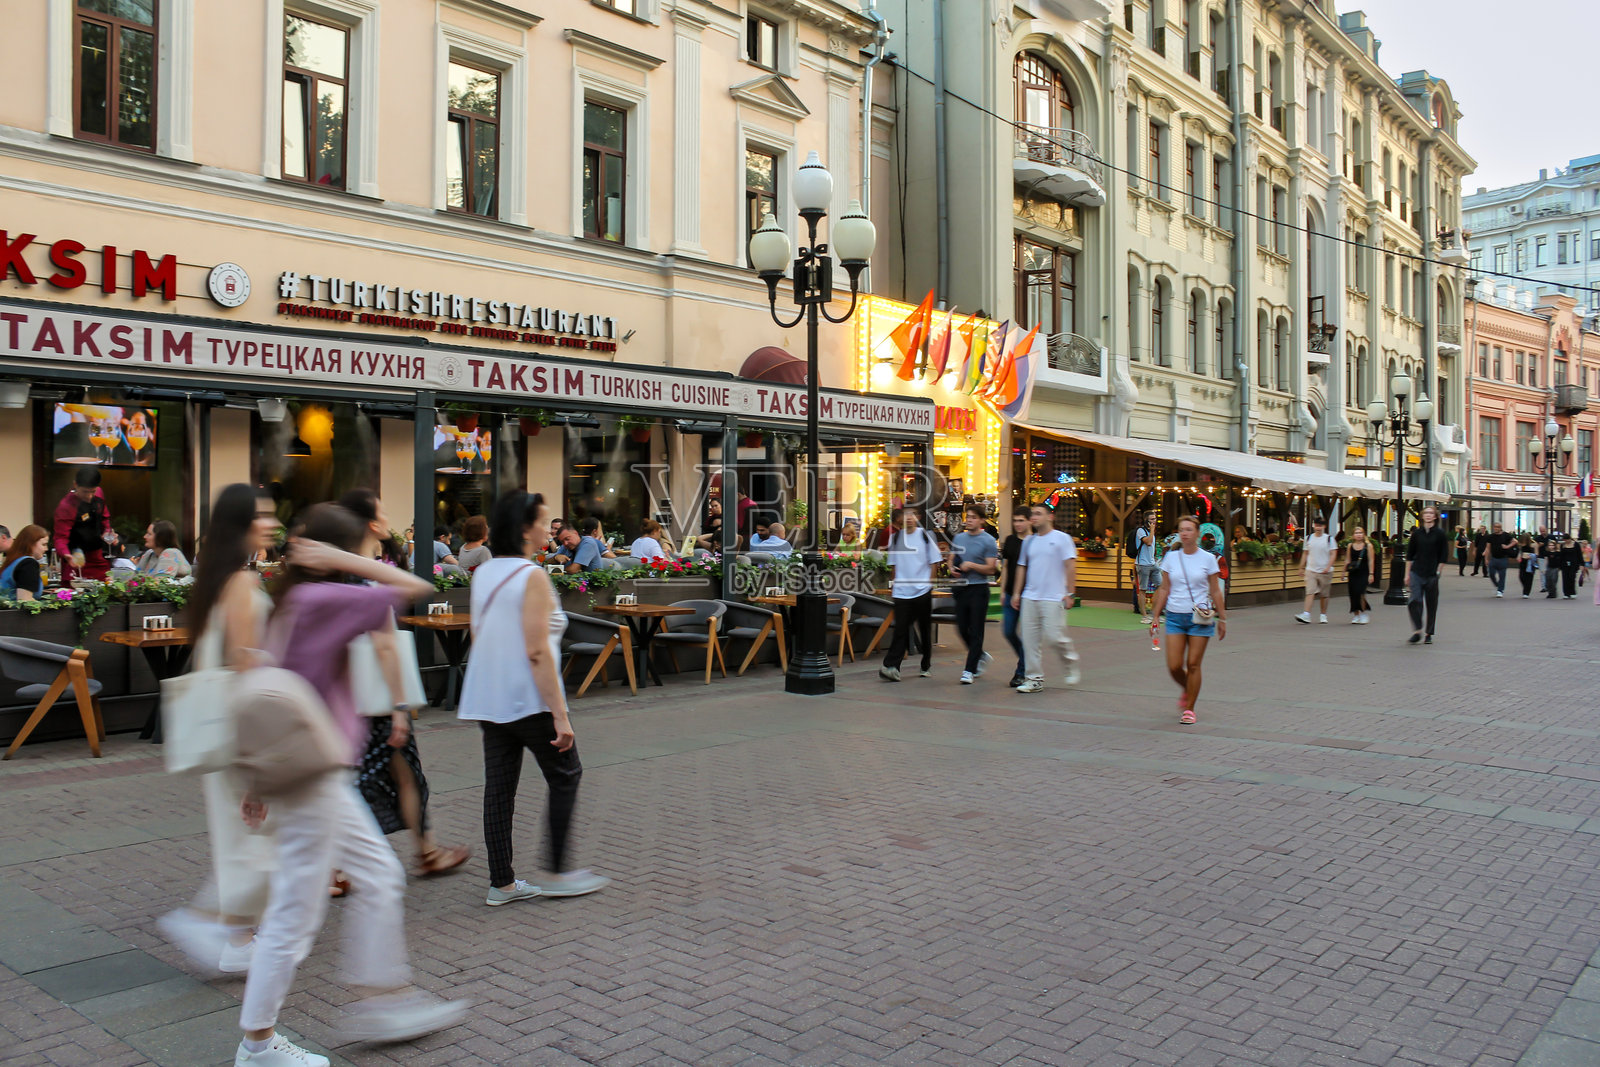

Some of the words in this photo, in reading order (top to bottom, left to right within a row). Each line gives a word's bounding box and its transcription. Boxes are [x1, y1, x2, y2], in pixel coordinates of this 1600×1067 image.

[0, 229, 177, 301] KSIM
[279, 271, 618, 339] #TURKISHRESTAURANT
[0, 312, 193, 365] TAKSIM
[207, 338, 342, 374] ТУРЕЦКАЯ
[351, 350, 425, 380] КУХНЯ
[467, 359, 584, 396] TAKSIM
[590, 374, 662, 401] TURKISH
[671, 383, 730, 406] CUISINE
[756, 389, 833, 418] TAKSM
[837, 401, 894, 423] ТУРЕЦКАЯ
[897, 408, 930, 426] КУХНЯ
